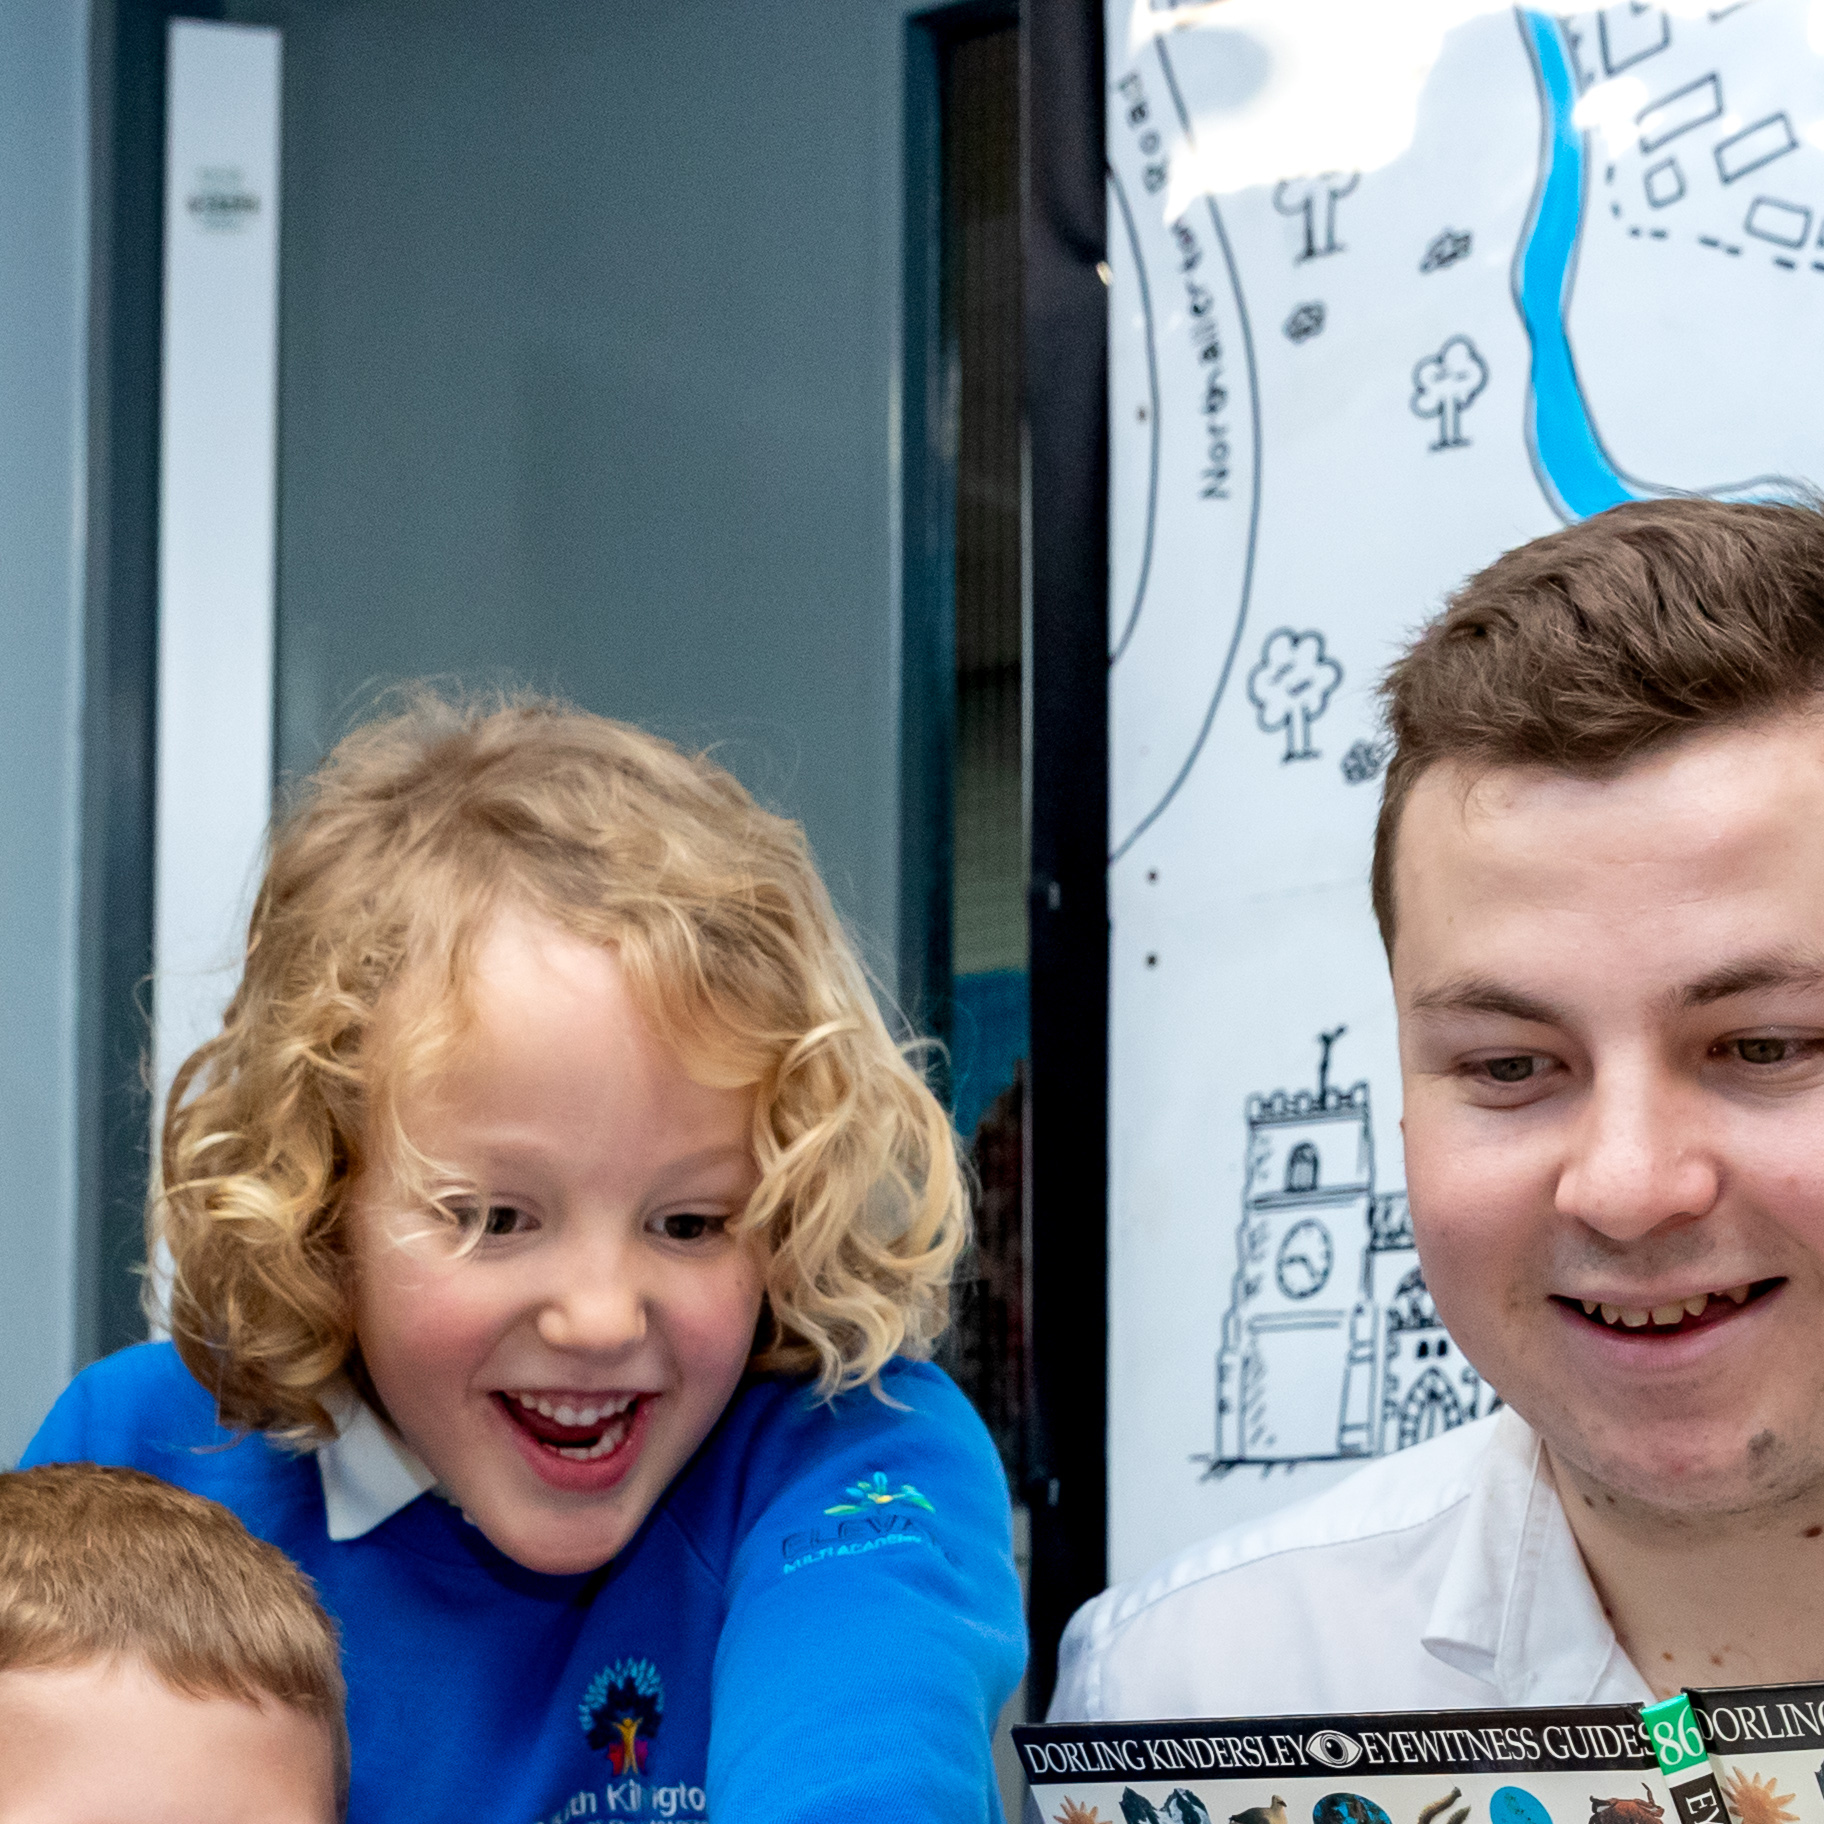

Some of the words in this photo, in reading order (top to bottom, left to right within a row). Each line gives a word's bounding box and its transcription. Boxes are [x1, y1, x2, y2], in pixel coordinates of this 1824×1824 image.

[1024, 1738, 1146, 1776] DORLING
[1148, 1732, 1309, 1771] KINDERSLEY
[1365, 1727, 1541, 1766] EYEWITNESS
[1653, 1704, 1705, 1766] 86
